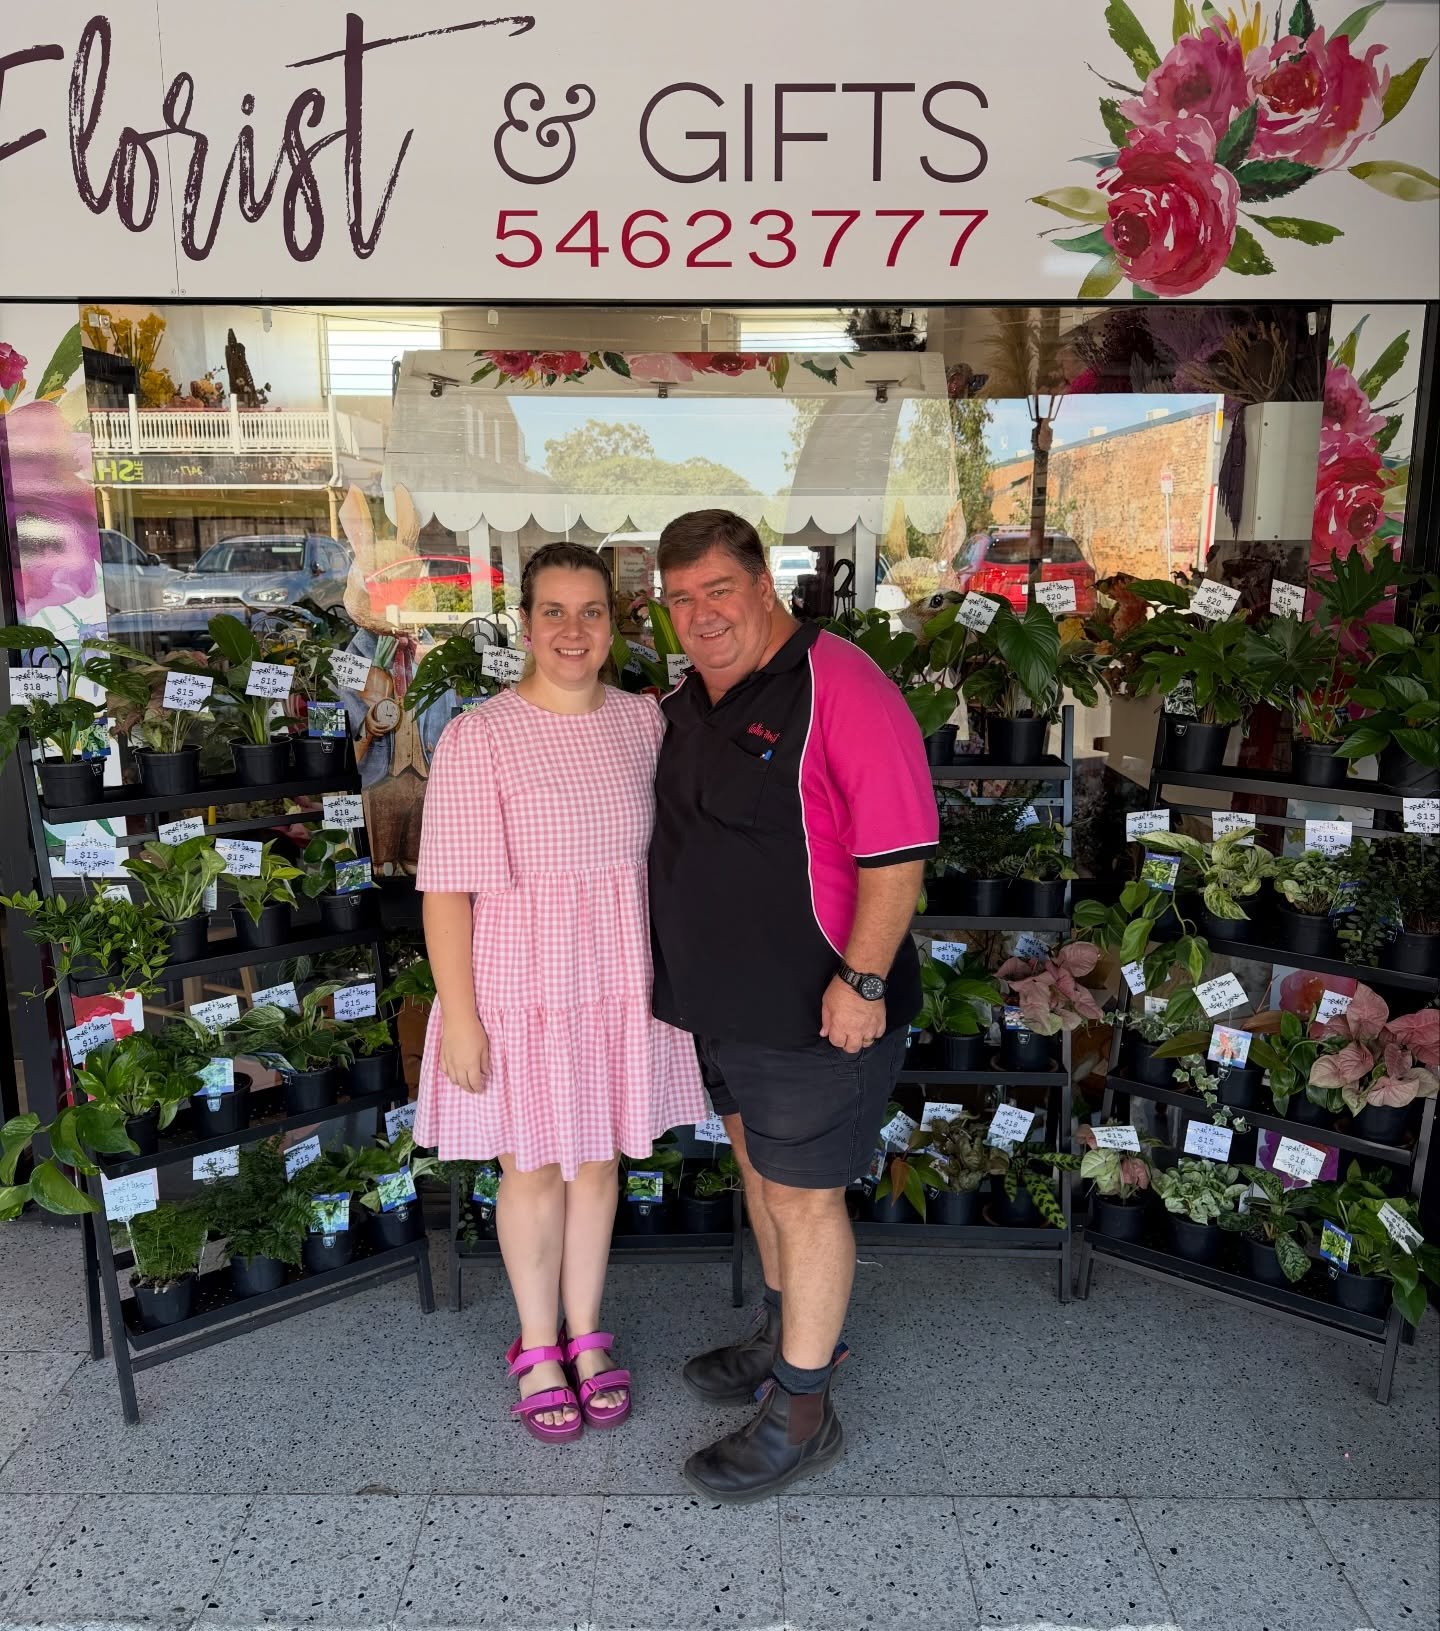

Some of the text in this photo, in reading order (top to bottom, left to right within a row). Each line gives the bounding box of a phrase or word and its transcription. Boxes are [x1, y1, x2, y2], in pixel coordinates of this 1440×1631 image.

[494, 82, 596, 185] &
[639, 81, 989, 183] GIFTS
[495, 209, 989, 269] 54623777
[1046, 593, 1062, 601] $20
[1206, 597, 1222, 607] $20
[493, 660, 509, 668] $18
[338, 665, 353, 675] $18
[261, 676, 277, 686] $15
[24, 683, 41, 691] $18
[176, 689, 194, 697] $15
[173, 833, 189, 843] $15
[1317, 835, 1335, 843] $15
[80, 851, 98, 859] $15
[227, 854, 245, 862] $15
[345, 1000, 361, 1008] $15
[82, 1036, 98, 1047] $15
[705, 1123, 721, 1131] $15
[296, 1155, 310, 1166] $15
